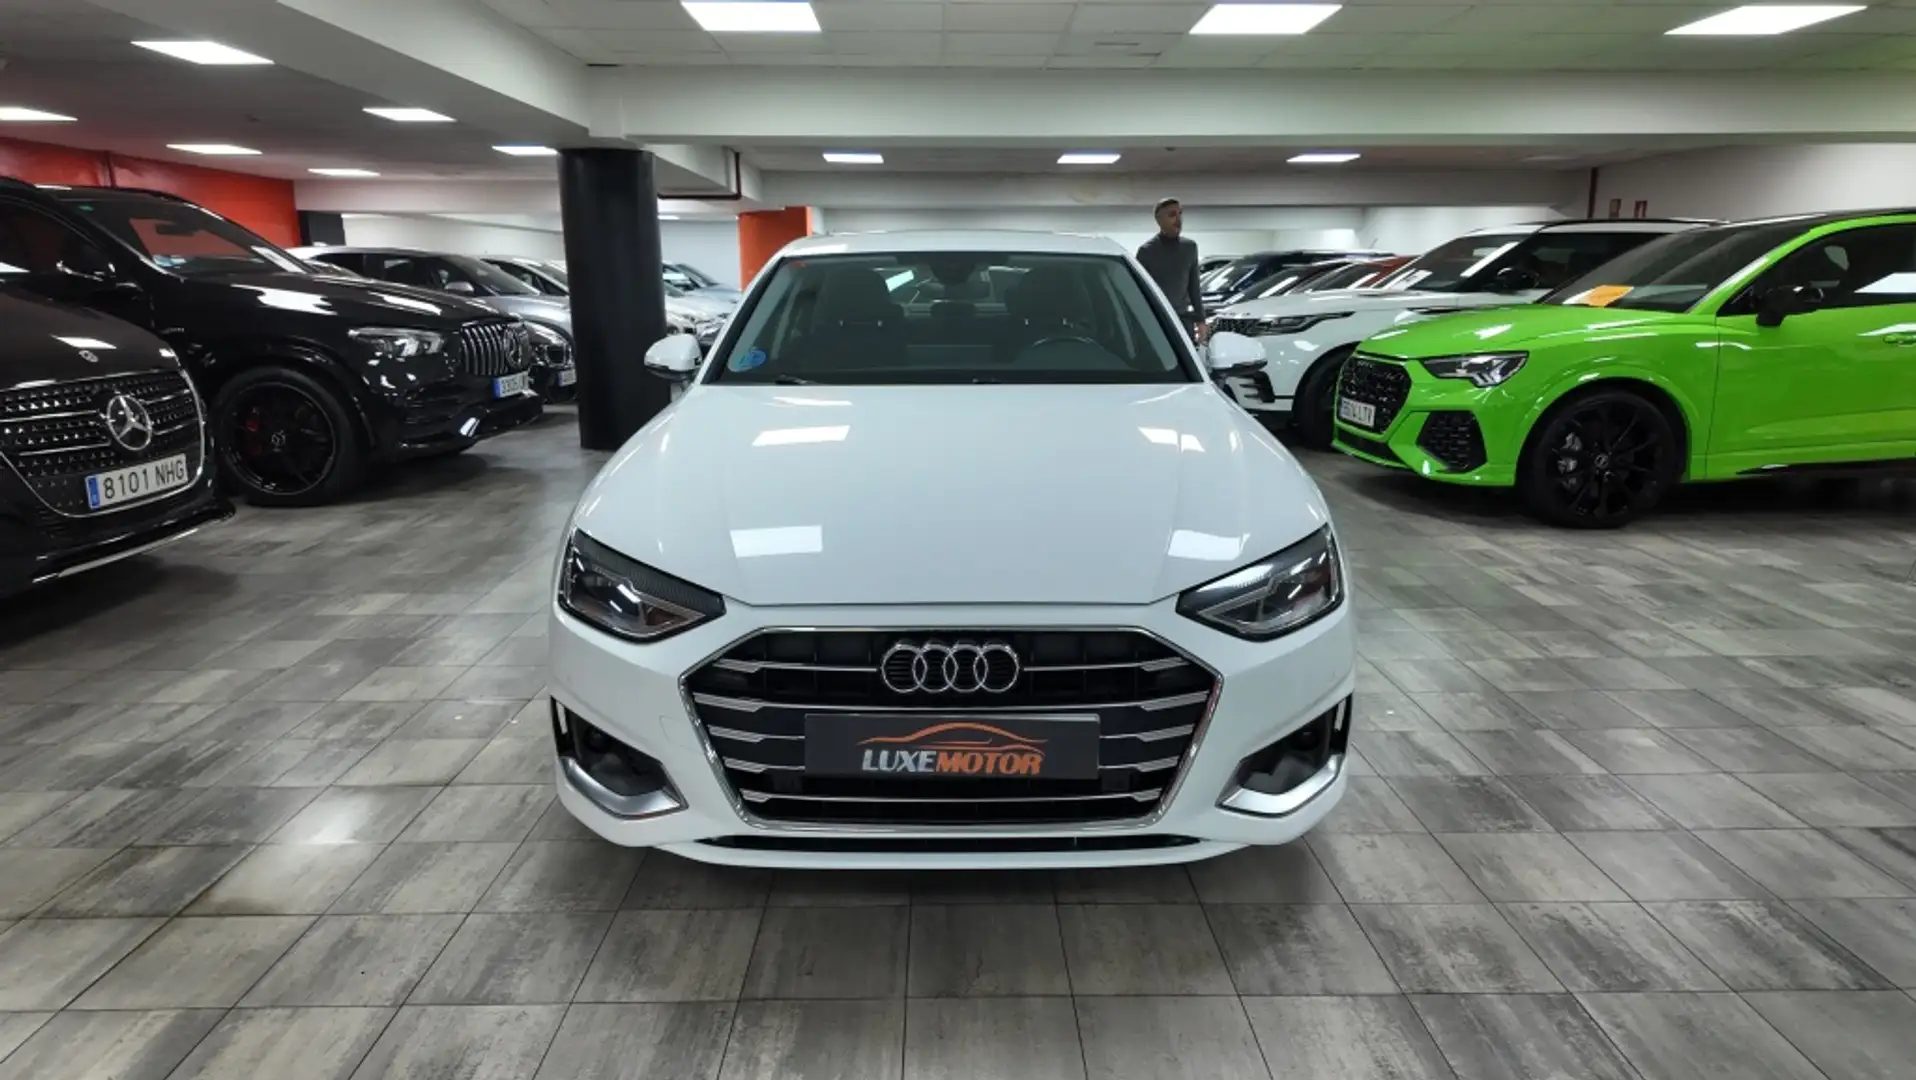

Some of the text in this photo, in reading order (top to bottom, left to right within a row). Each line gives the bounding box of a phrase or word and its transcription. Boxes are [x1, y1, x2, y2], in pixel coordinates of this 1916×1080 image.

[103, 460, 184, 499] 8101 NHG
[862, 749, 1043, 775] LUXEMOTOR
